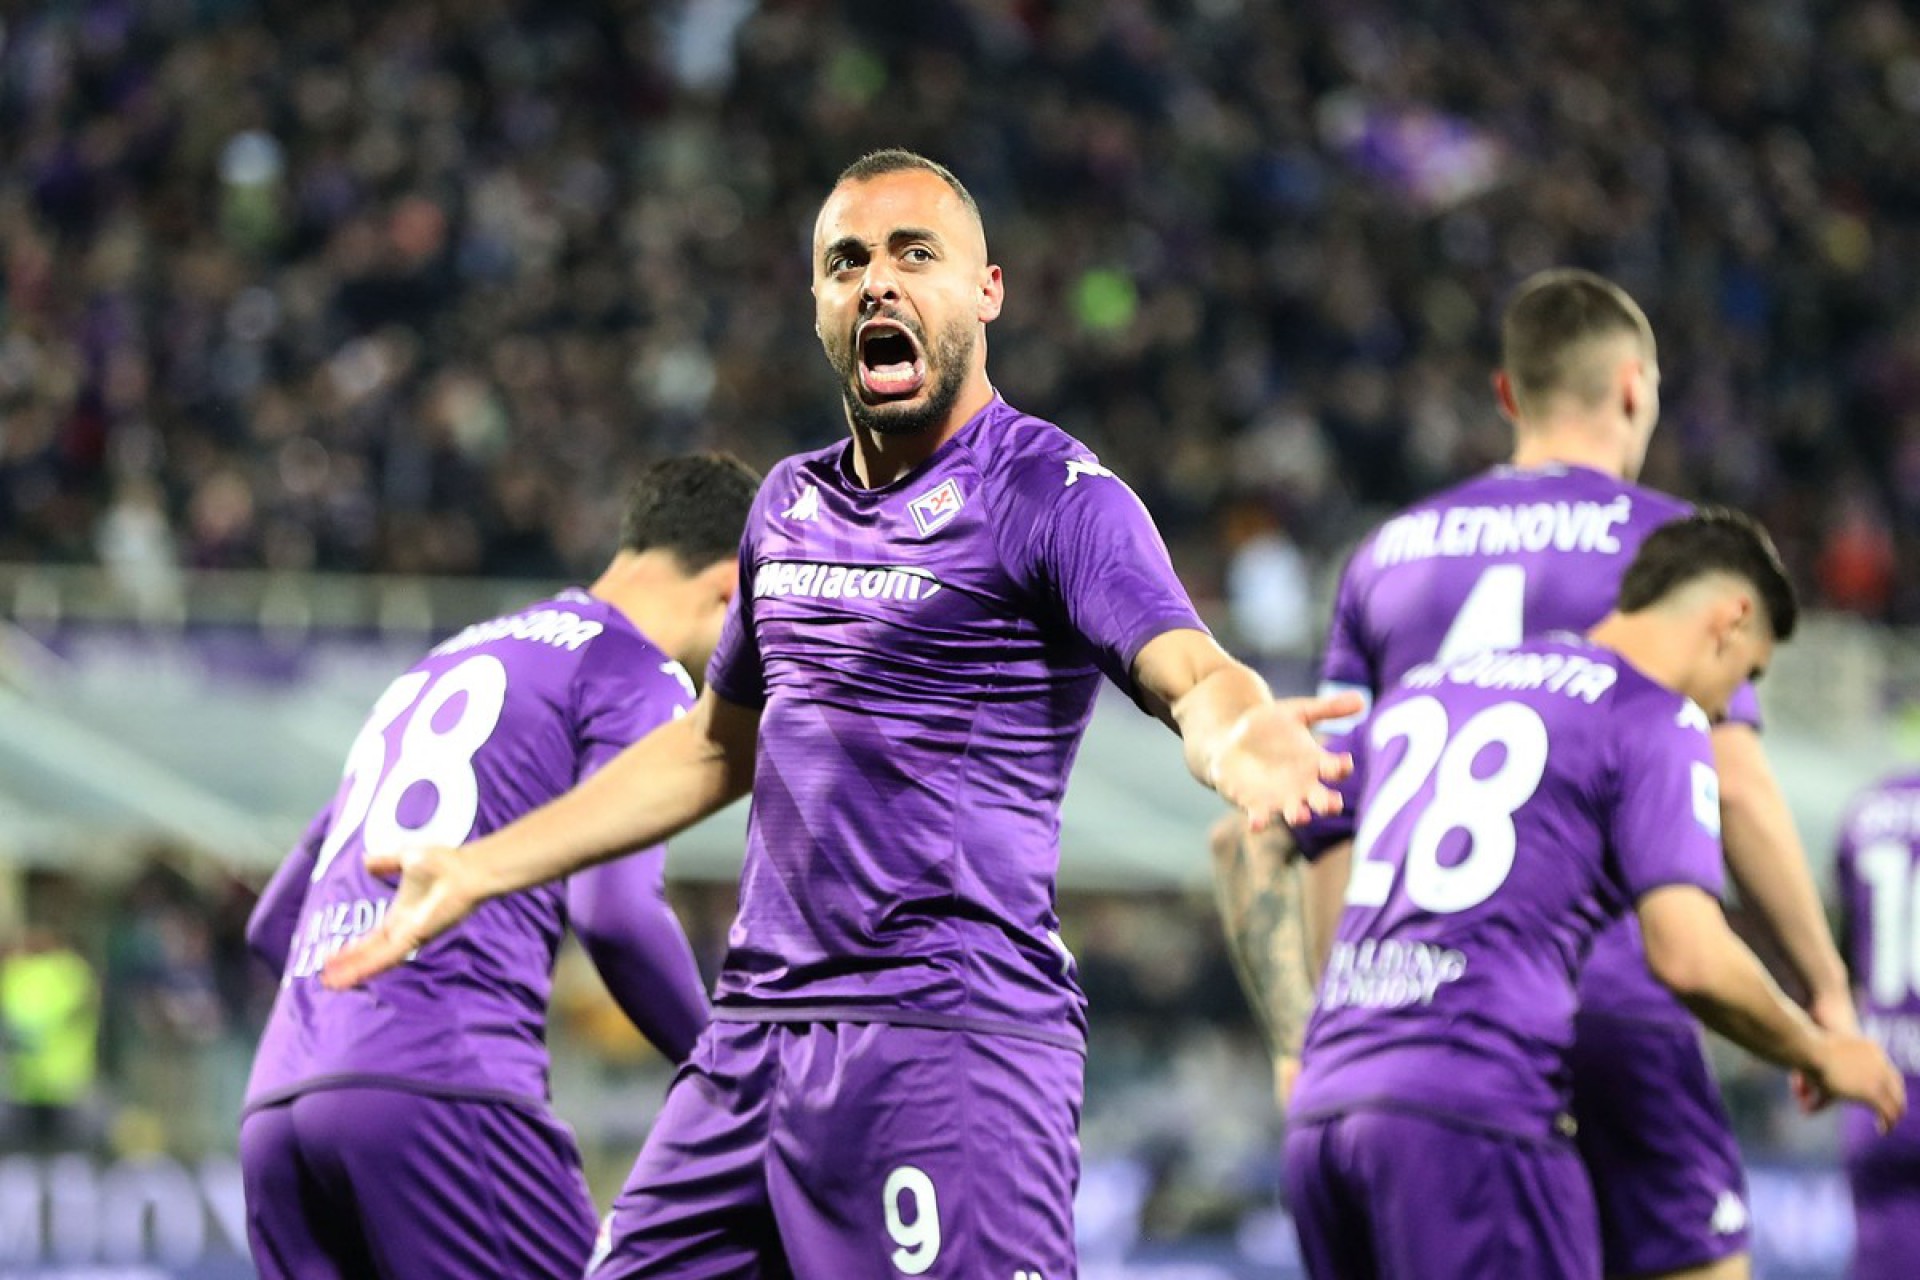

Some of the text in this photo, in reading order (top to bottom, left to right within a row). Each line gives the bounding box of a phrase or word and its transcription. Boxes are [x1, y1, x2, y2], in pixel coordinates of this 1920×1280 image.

[754, 562, 922, 600] Mediacom
[1436, 565, 1526, 664] 4
[1345, 695, 1550, 914] 28
[1853, 840, 1920, 1008] 1
[883, 1166, 941, 1275] 9
